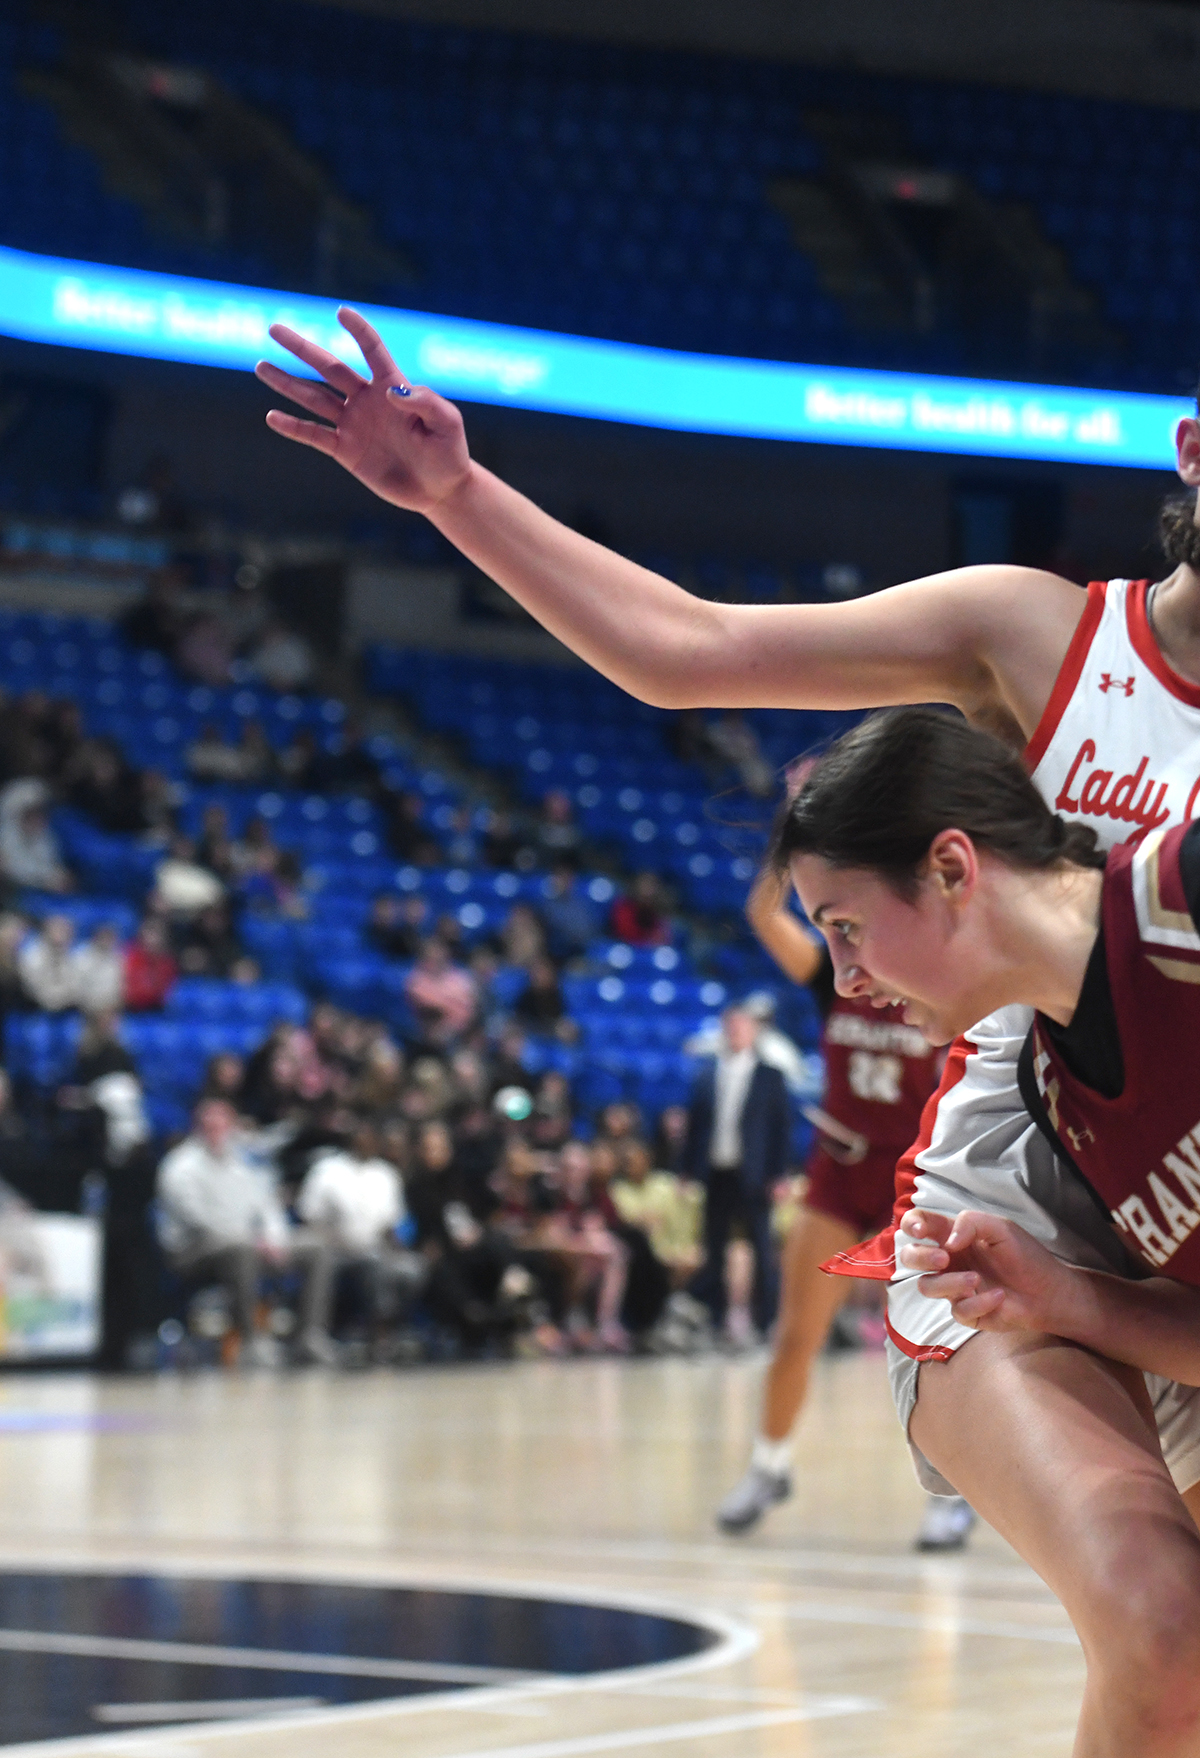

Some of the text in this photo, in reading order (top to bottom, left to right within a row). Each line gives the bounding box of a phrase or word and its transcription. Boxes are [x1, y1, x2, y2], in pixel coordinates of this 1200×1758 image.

[804, 381, 907, 428] Better
[911, 390, 1016, 437] health
[1020, 398, 1069, 442] for
[1055, 738, 1170, 847] Lady
